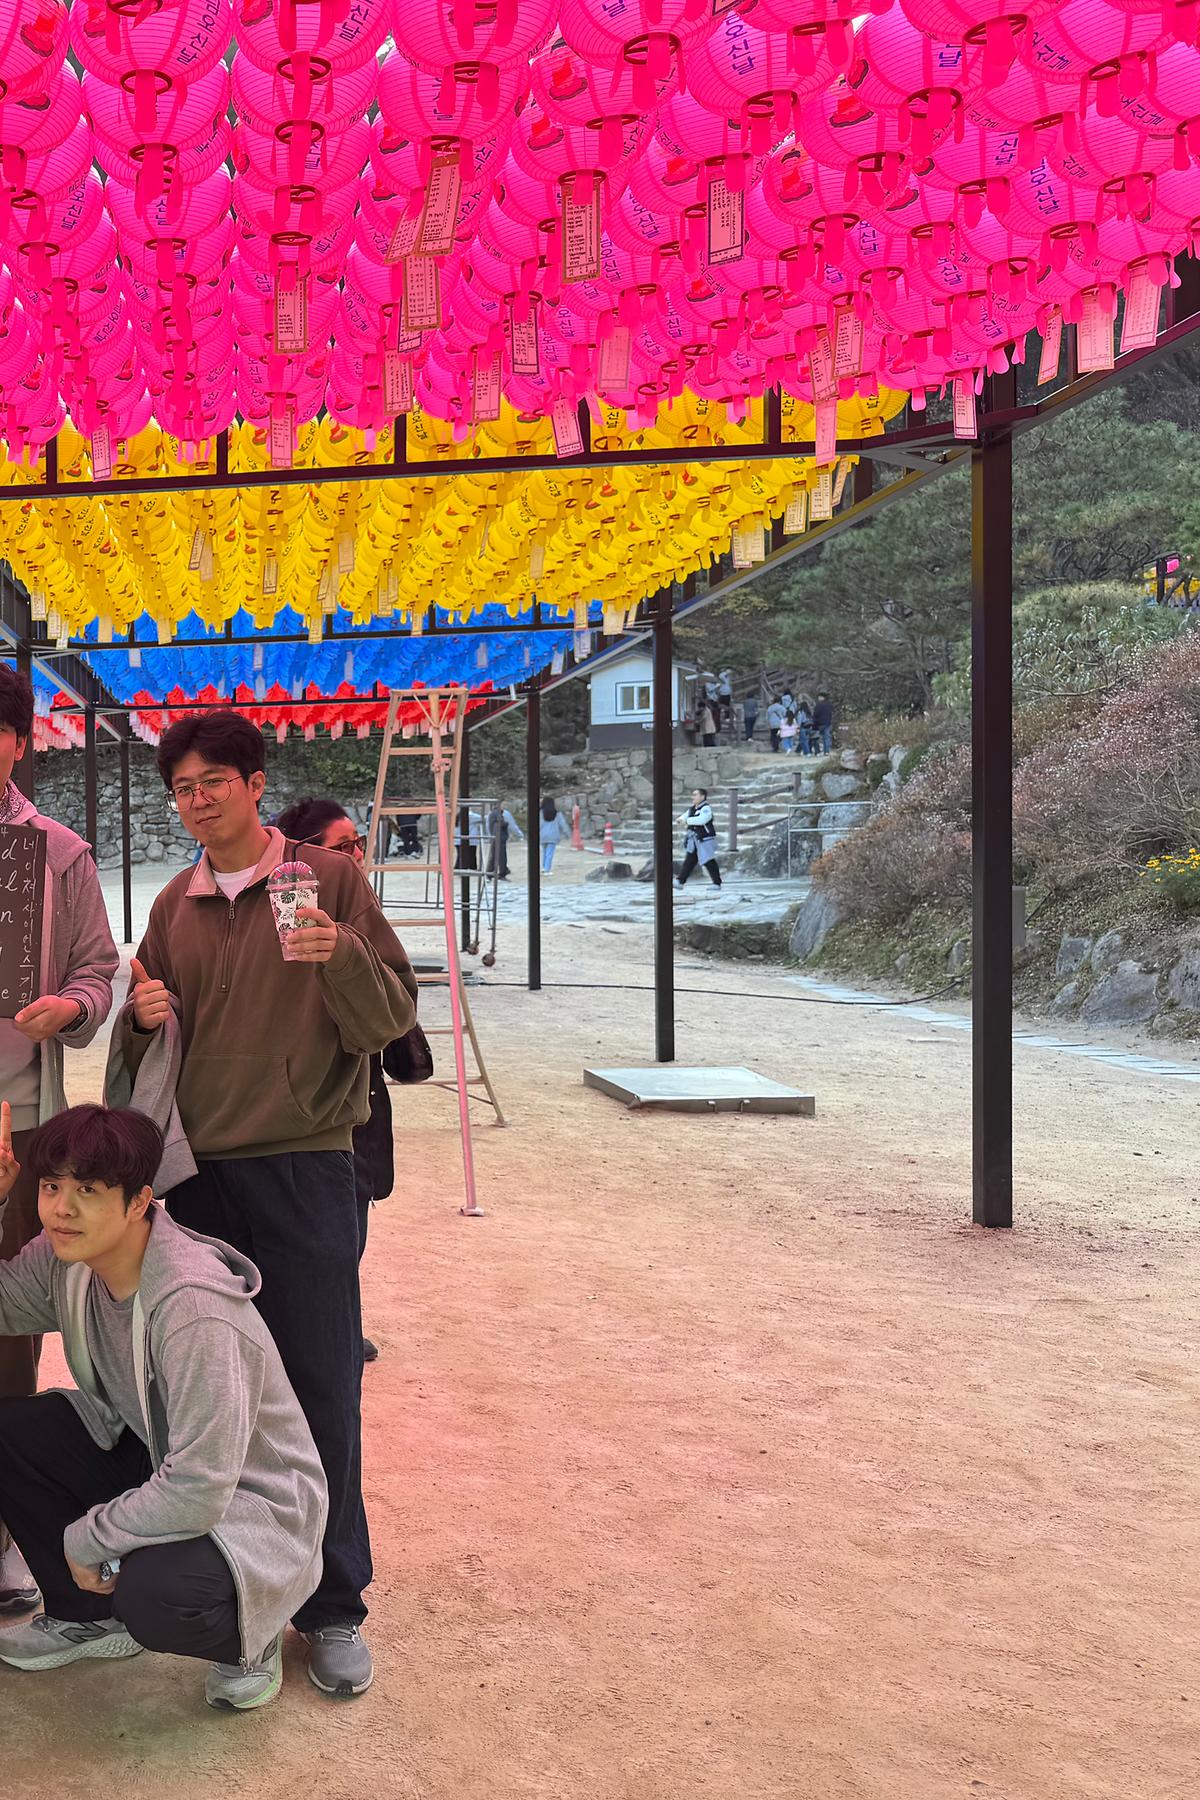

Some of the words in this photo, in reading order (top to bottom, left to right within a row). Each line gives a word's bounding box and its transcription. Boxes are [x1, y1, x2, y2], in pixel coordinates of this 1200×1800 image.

[339, 0, 371, 42] 신날
[600, 0, 627, 18] 날
[938, 44, 962, 68] 날
[995, 131, 1019, 167] 신날
